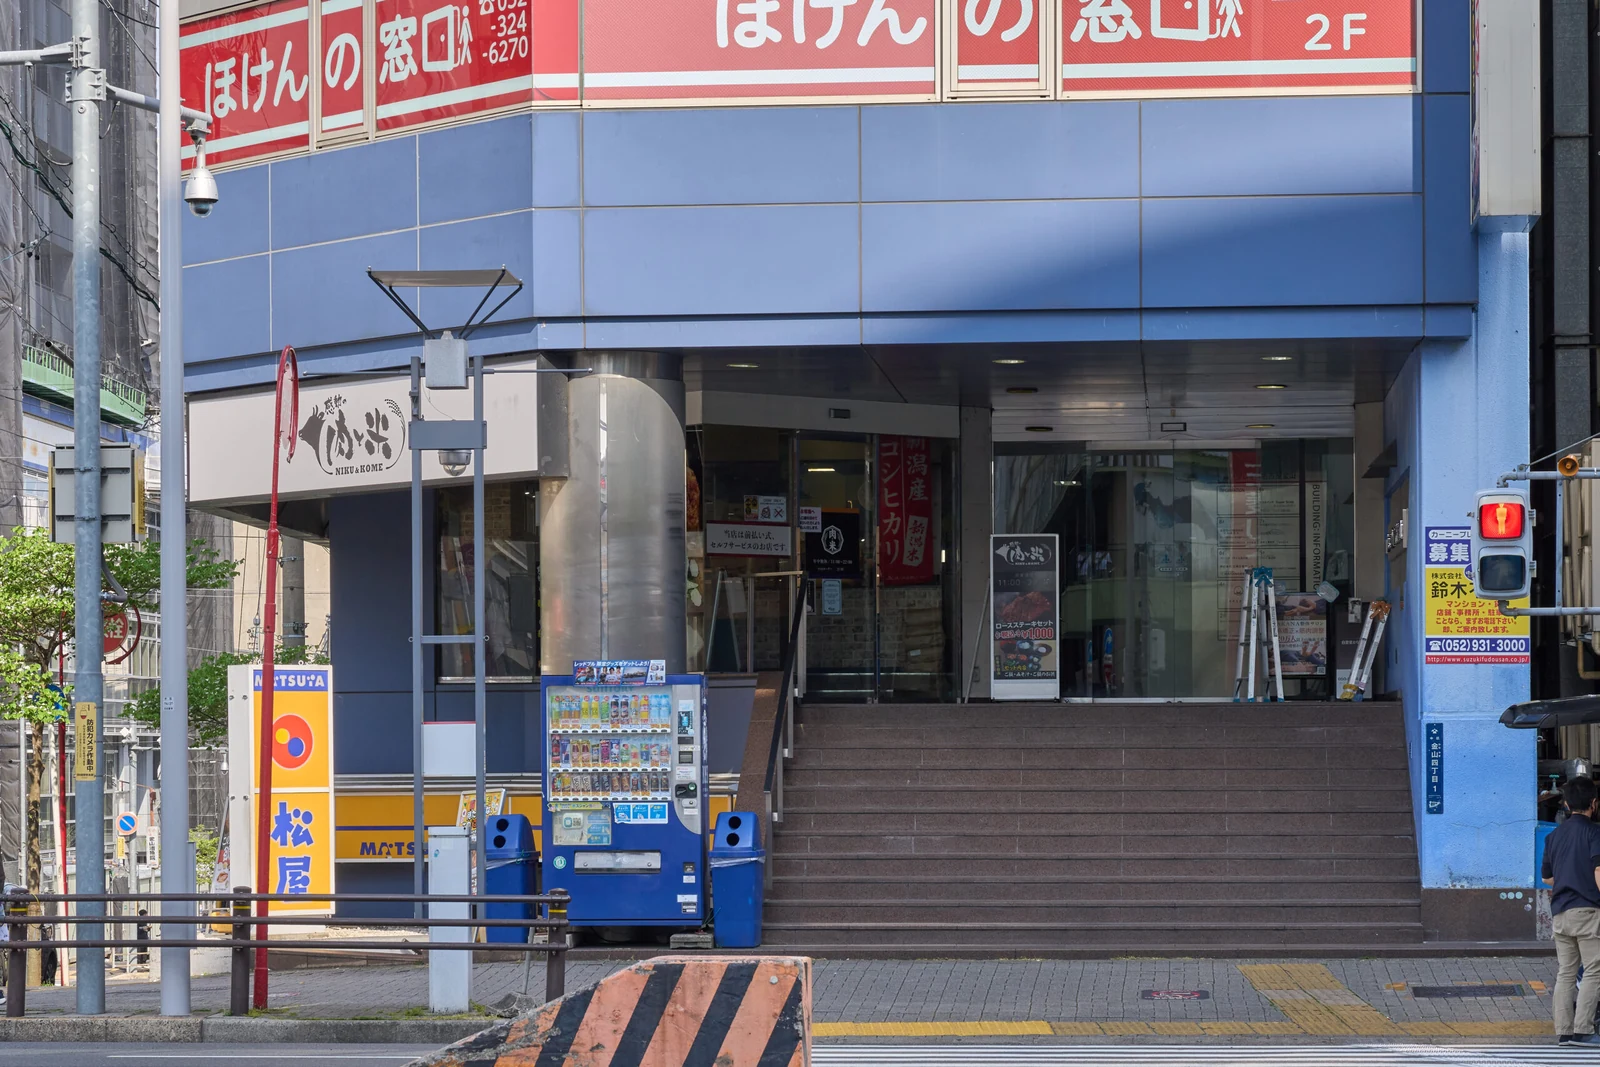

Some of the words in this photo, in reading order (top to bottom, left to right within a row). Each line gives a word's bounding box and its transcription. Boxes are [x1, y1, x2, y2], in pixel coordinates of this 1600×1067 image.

[490, 9, 527, 37] -324
[1304, 13, 1367, 50] 2F
[482, 35, 528, 64] -6270
[335, 463, 383, 476] NIKU&KOME
[880, 441, 901, 565] コシヒカリ
[724, 529, 775, 540] 当店は前払い式、
[1429, 543, 1469, 562] 募集
[1431, 572, 1462, 580] 株式会社
[995, 620, 1054, 629] ロースステーキセット
[1436, 617, 1517, 625] ことなら、まずお電話下さい。
[1441, 639, 1525, 652] (052)931-3000
[86, 719, 94, 772] 防犯カメラ作動中
[271, 801, 314, 903] 松屋
